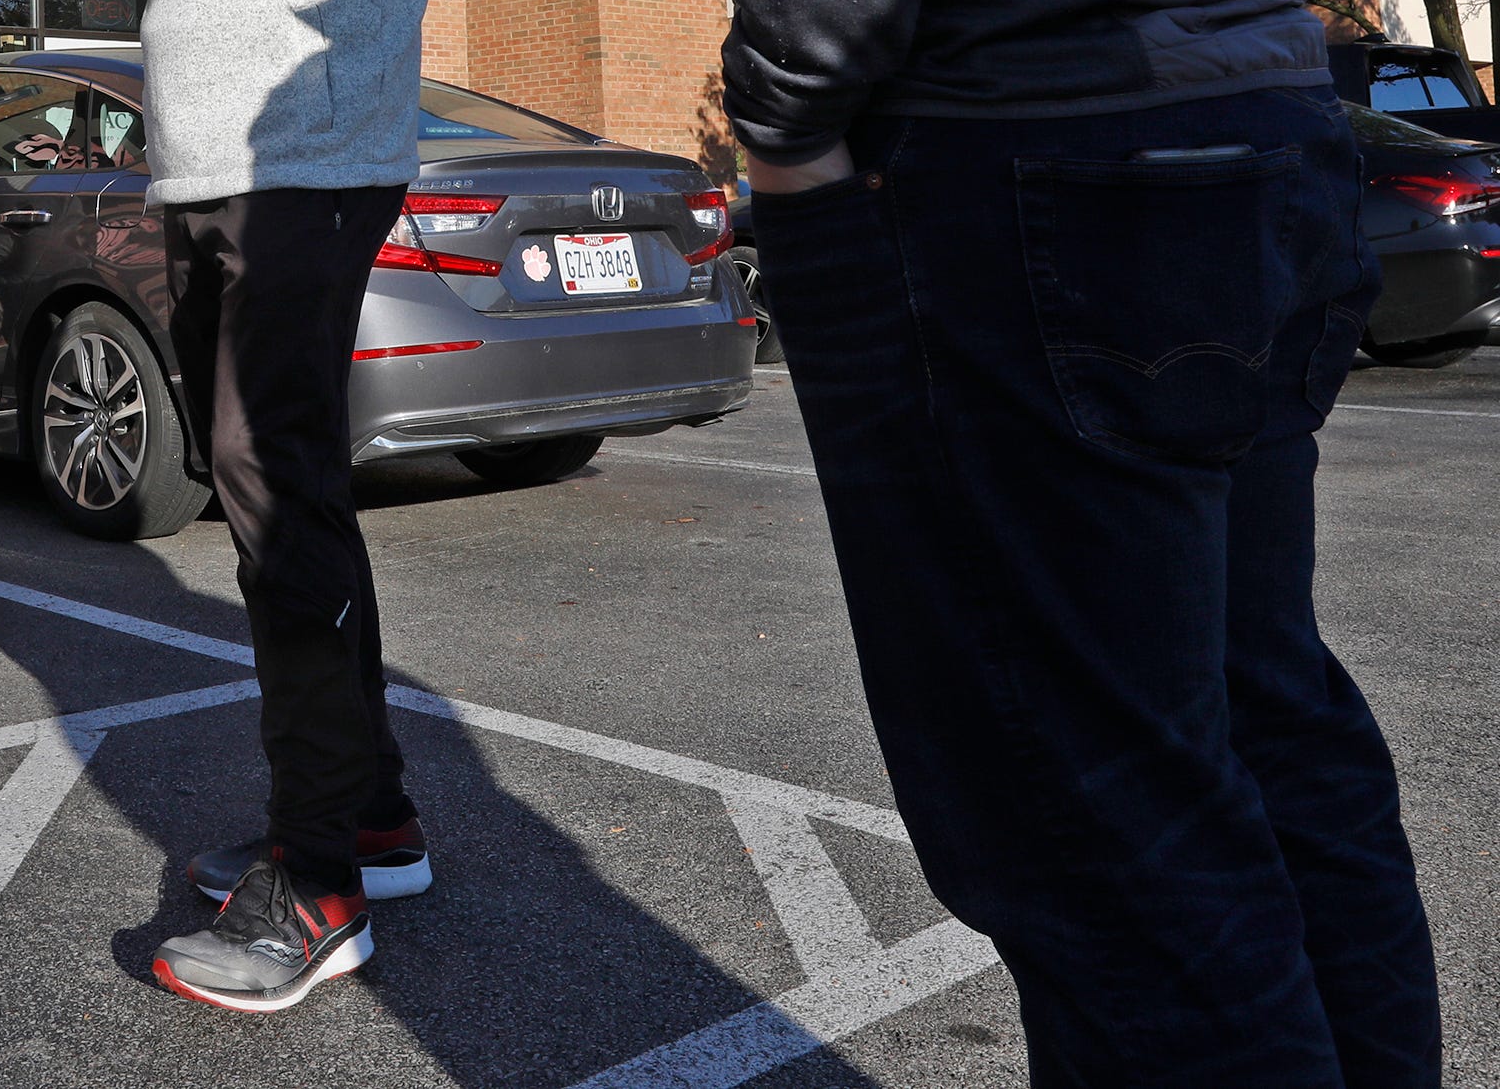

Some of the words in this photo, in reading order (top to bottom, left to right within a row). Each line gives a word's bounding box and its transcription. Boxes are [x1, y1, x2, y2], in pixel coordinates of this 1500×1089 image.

[85, 0, 132, 22] OPEN
[583, 237, 603, 246] OHIO
[565, 250, 595, 278] GZH
[596, 250, 634, 278] 3848
